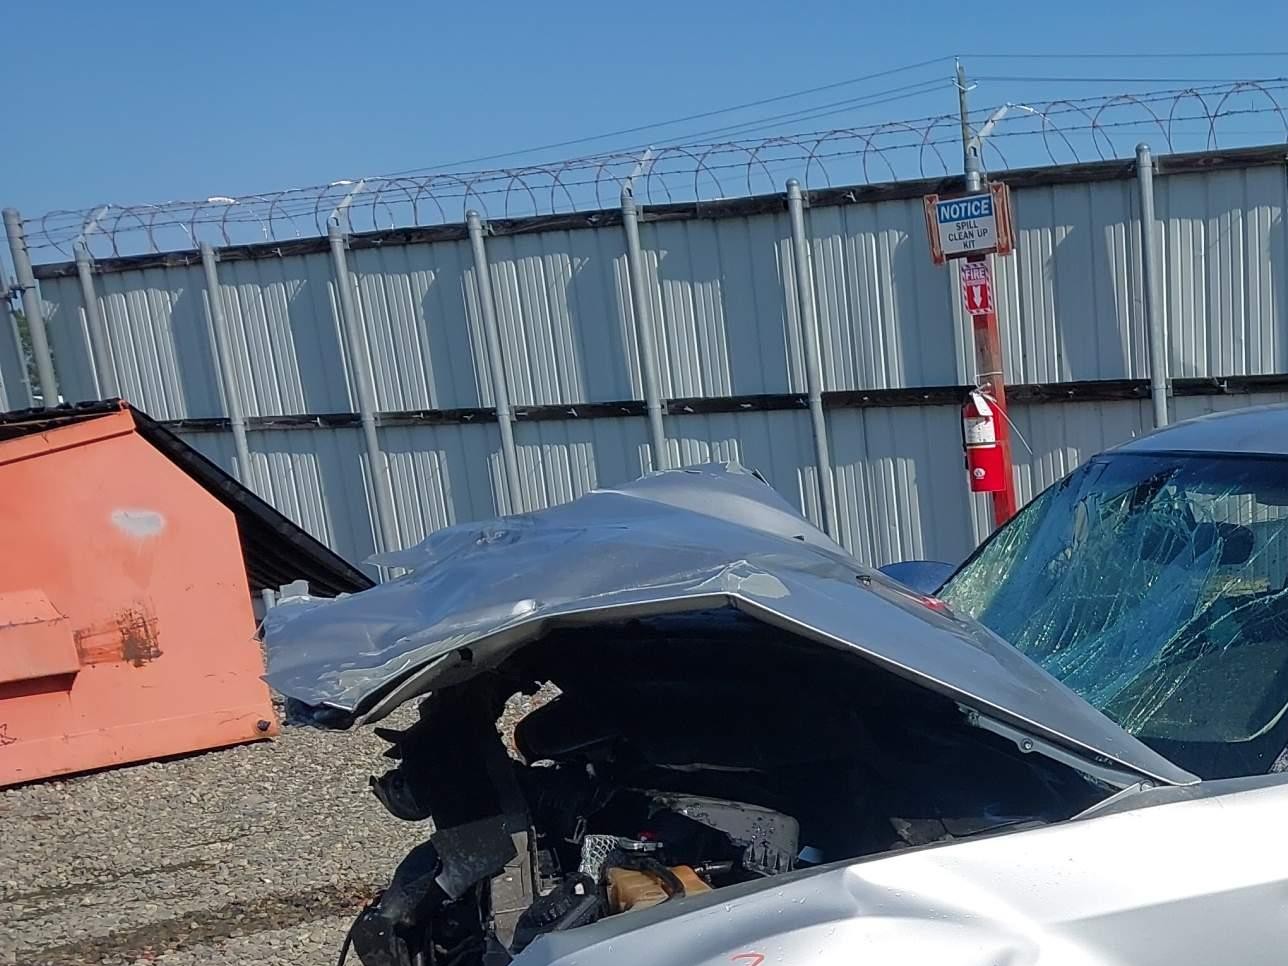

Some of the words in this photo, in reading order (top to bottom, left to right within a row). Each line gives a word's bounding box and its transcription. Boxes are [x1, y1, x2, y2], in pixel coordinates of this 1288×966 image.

[940, 199, 990, 221] NOTICE
[956, 219, 978, 231] SPILL
[948, 230, 974, 242] CLEAN
[977, 228, 988, 238] UP
[963, 239, 976, 249] KIT
[965, 268, 986, 281] FIRE
